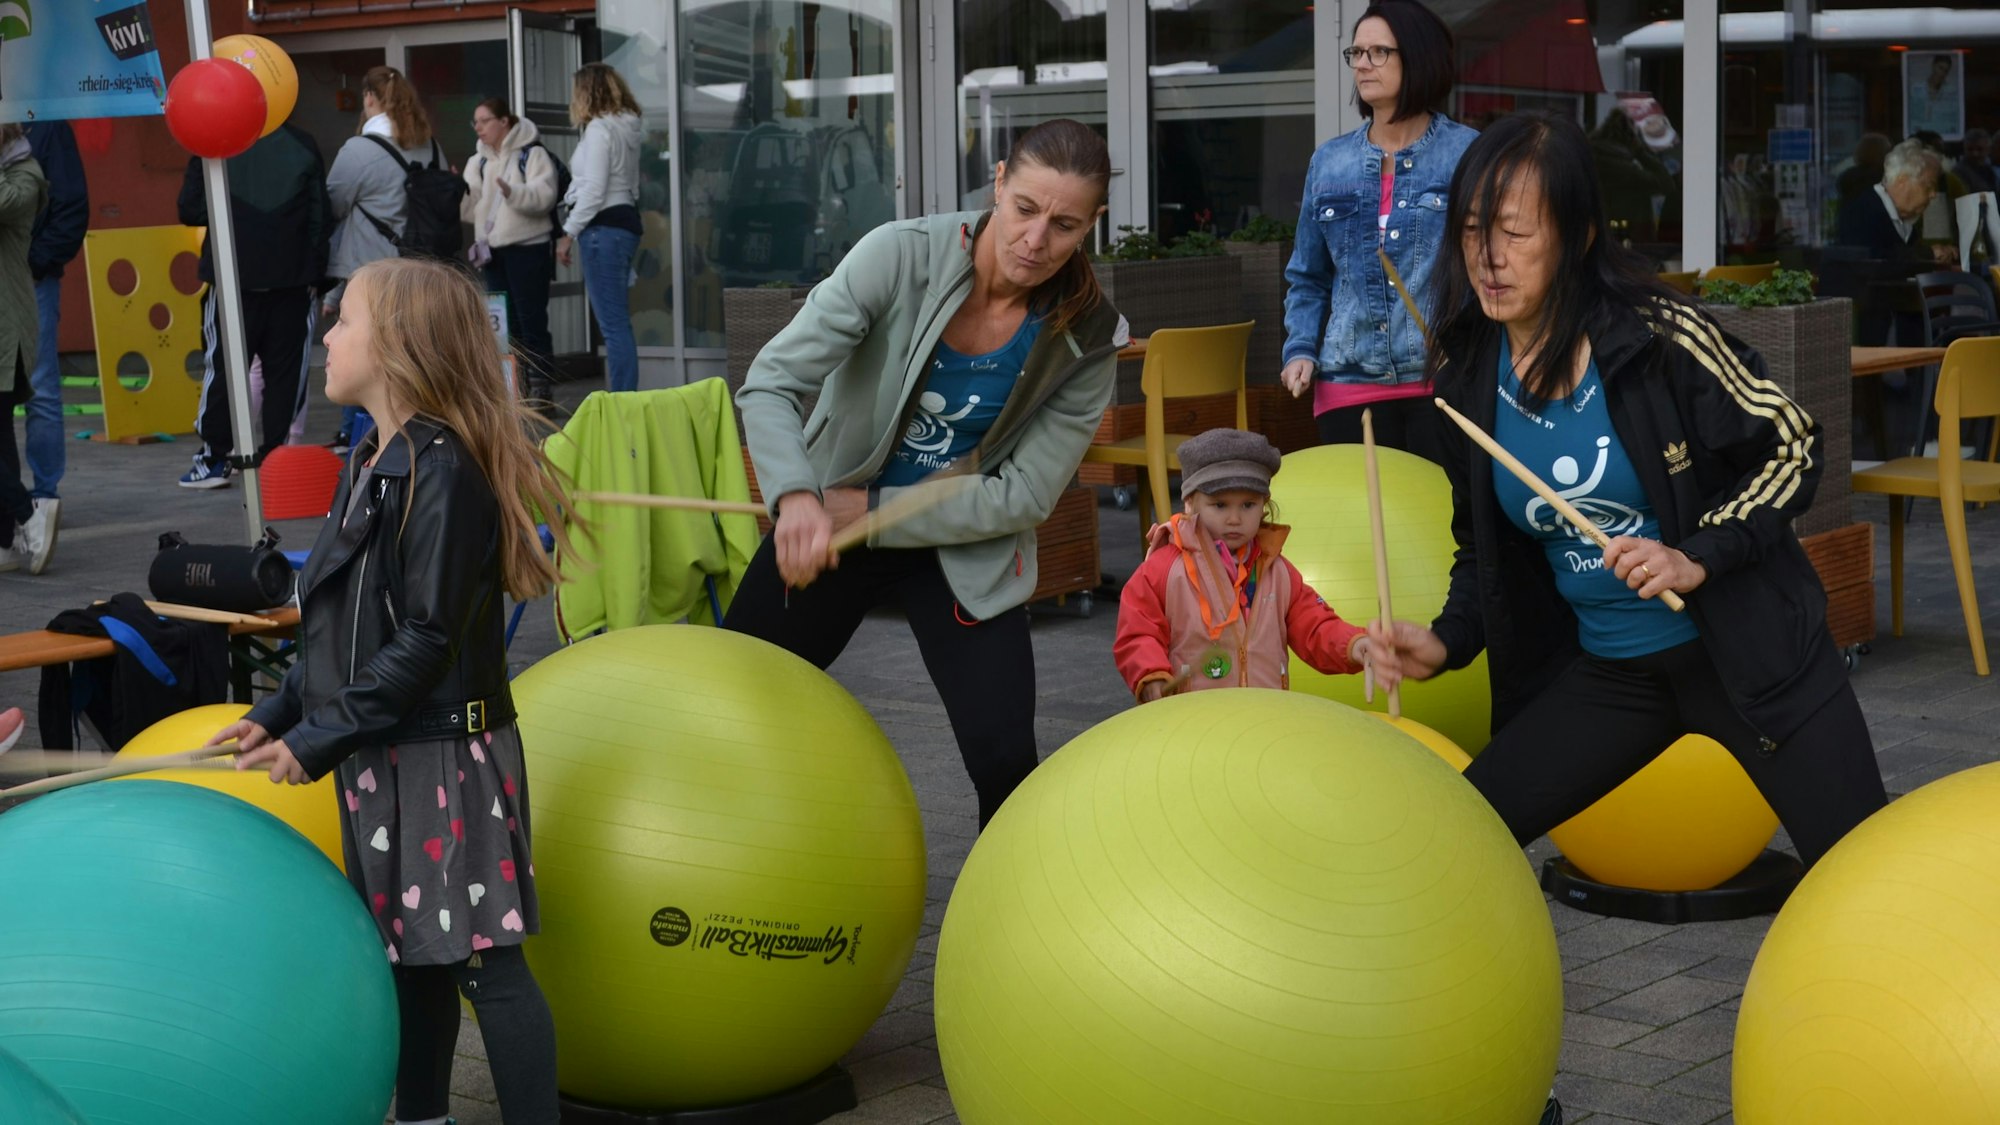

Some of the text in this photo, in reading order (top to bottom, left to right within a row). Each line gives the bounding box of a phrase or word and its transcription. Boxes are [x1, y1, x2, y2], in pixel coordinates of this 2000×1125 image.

[1544, 420, 1556, 430] TV
[1668, 458, 1692, 475] adida
[185, 562, 216, 587] JBL
[748, 917, 800, 931] ORIGINAL
